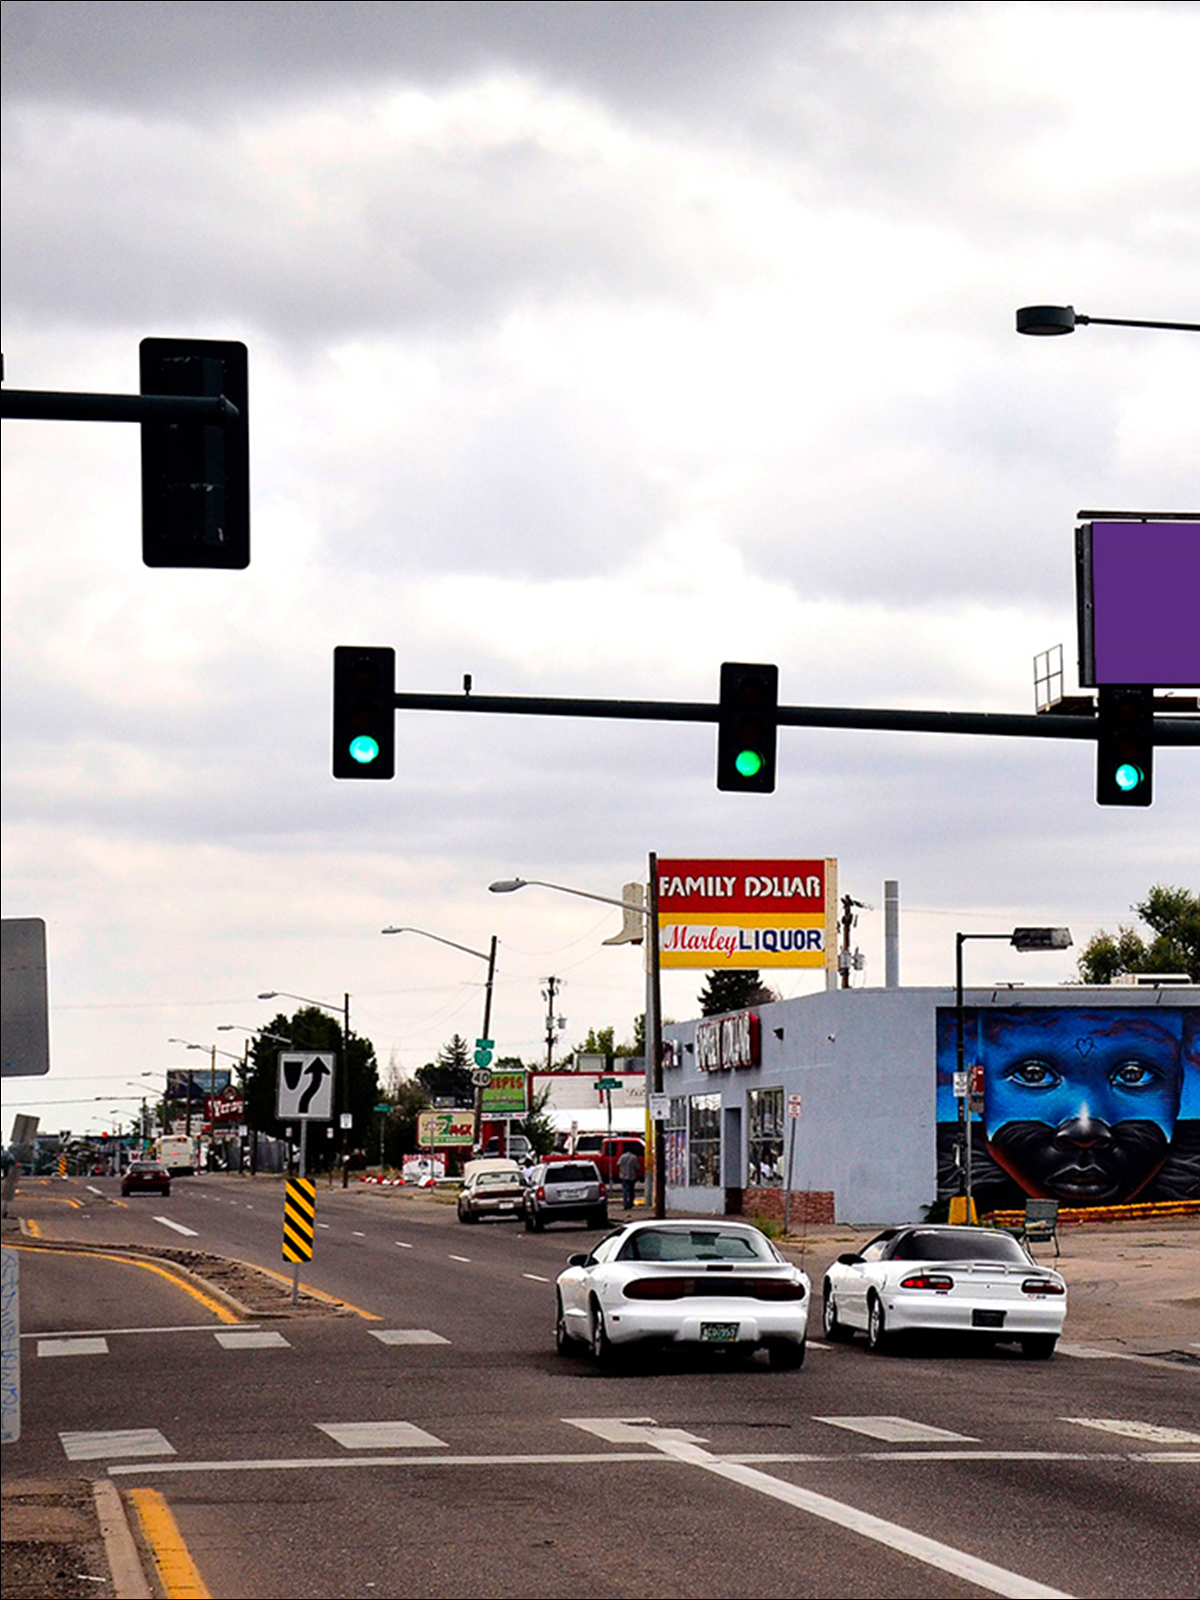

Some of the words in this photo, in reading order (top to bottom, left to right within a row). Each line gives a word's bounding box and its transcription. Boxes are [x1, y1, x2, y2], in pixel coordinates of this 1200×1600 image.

[658, 876, 737, 897] FAMILY
[744, 876, 821, 898] DOLLAR
[664, 925, 738, 959] Marley
[738, 929, 823, 953] LIQUOR
[473, 1071, 490, 1086] 40
